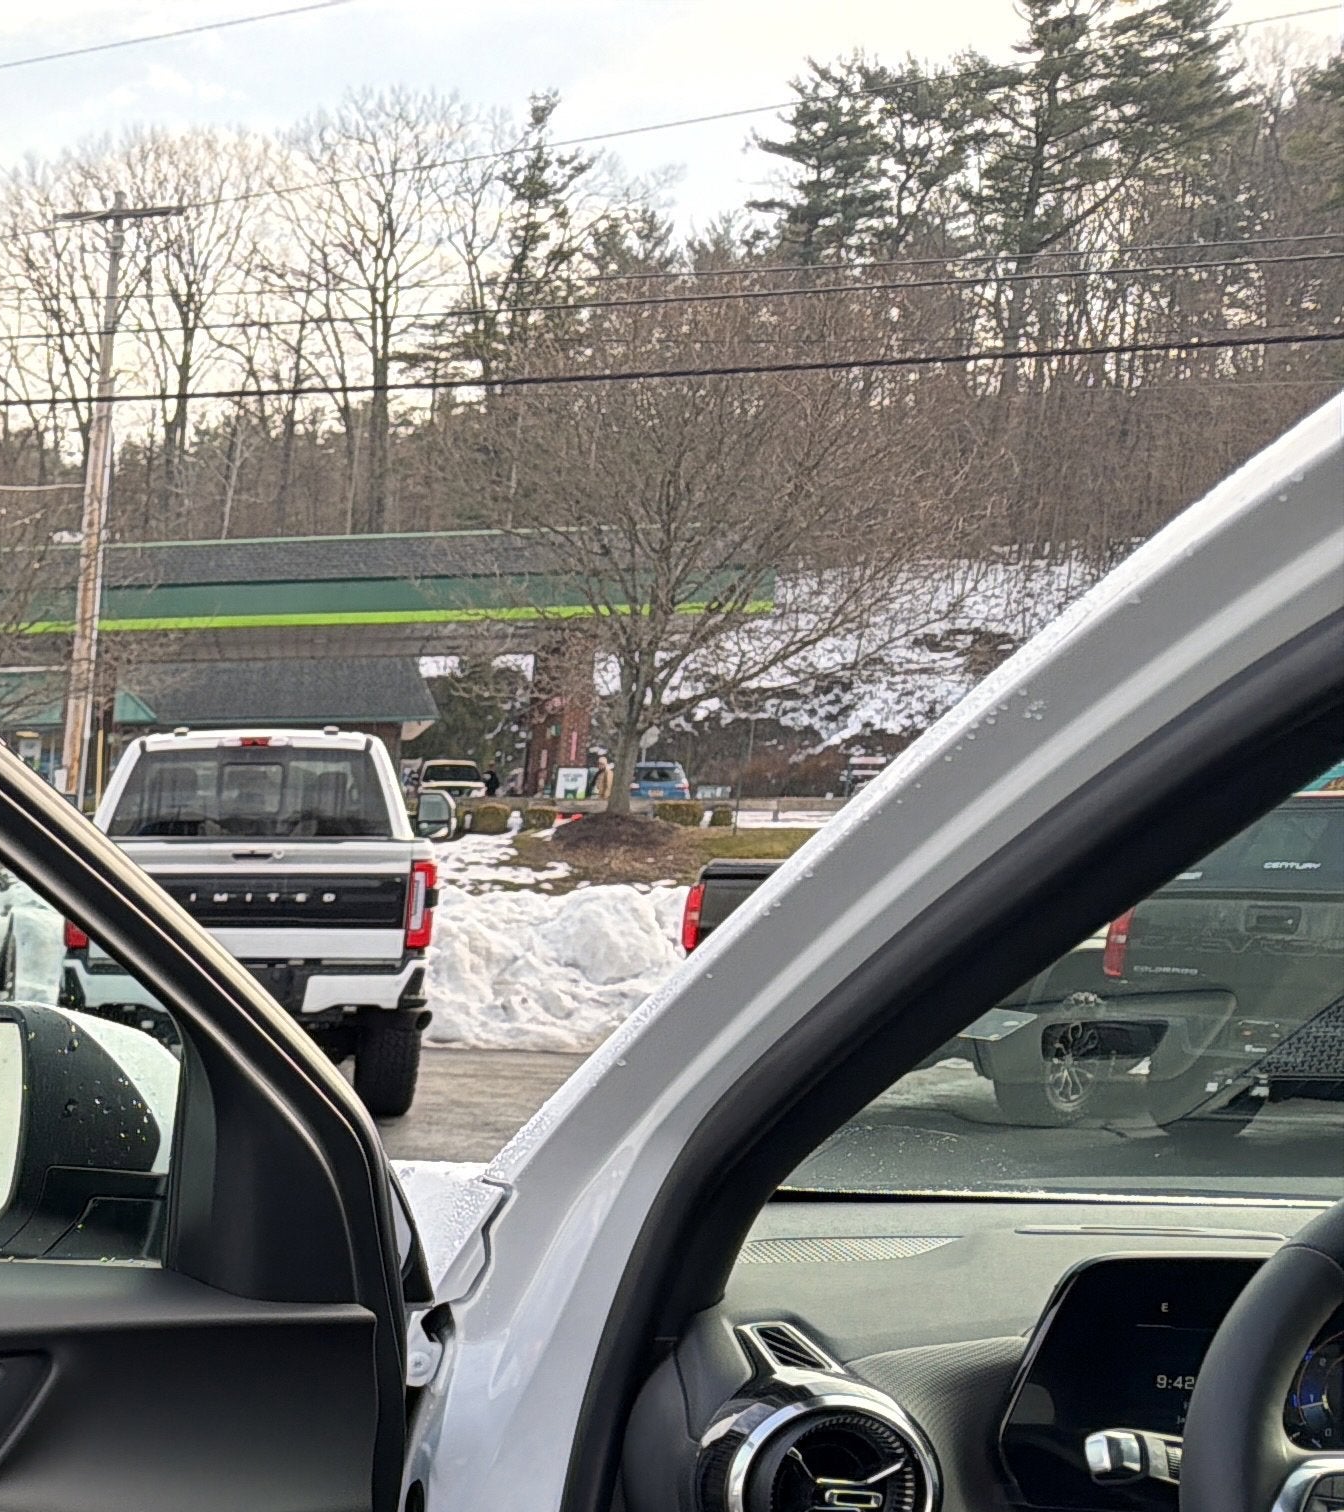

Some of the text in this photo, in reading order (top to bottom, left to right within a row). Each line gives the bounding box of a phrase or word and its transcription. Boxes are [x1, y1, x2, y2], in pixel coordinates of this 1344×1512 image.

[1263, 861, 1322, 870] CENTURY
[190, 893, 336, 902] IMITED
[1156, 1374, 1195, 1390] 9:42
